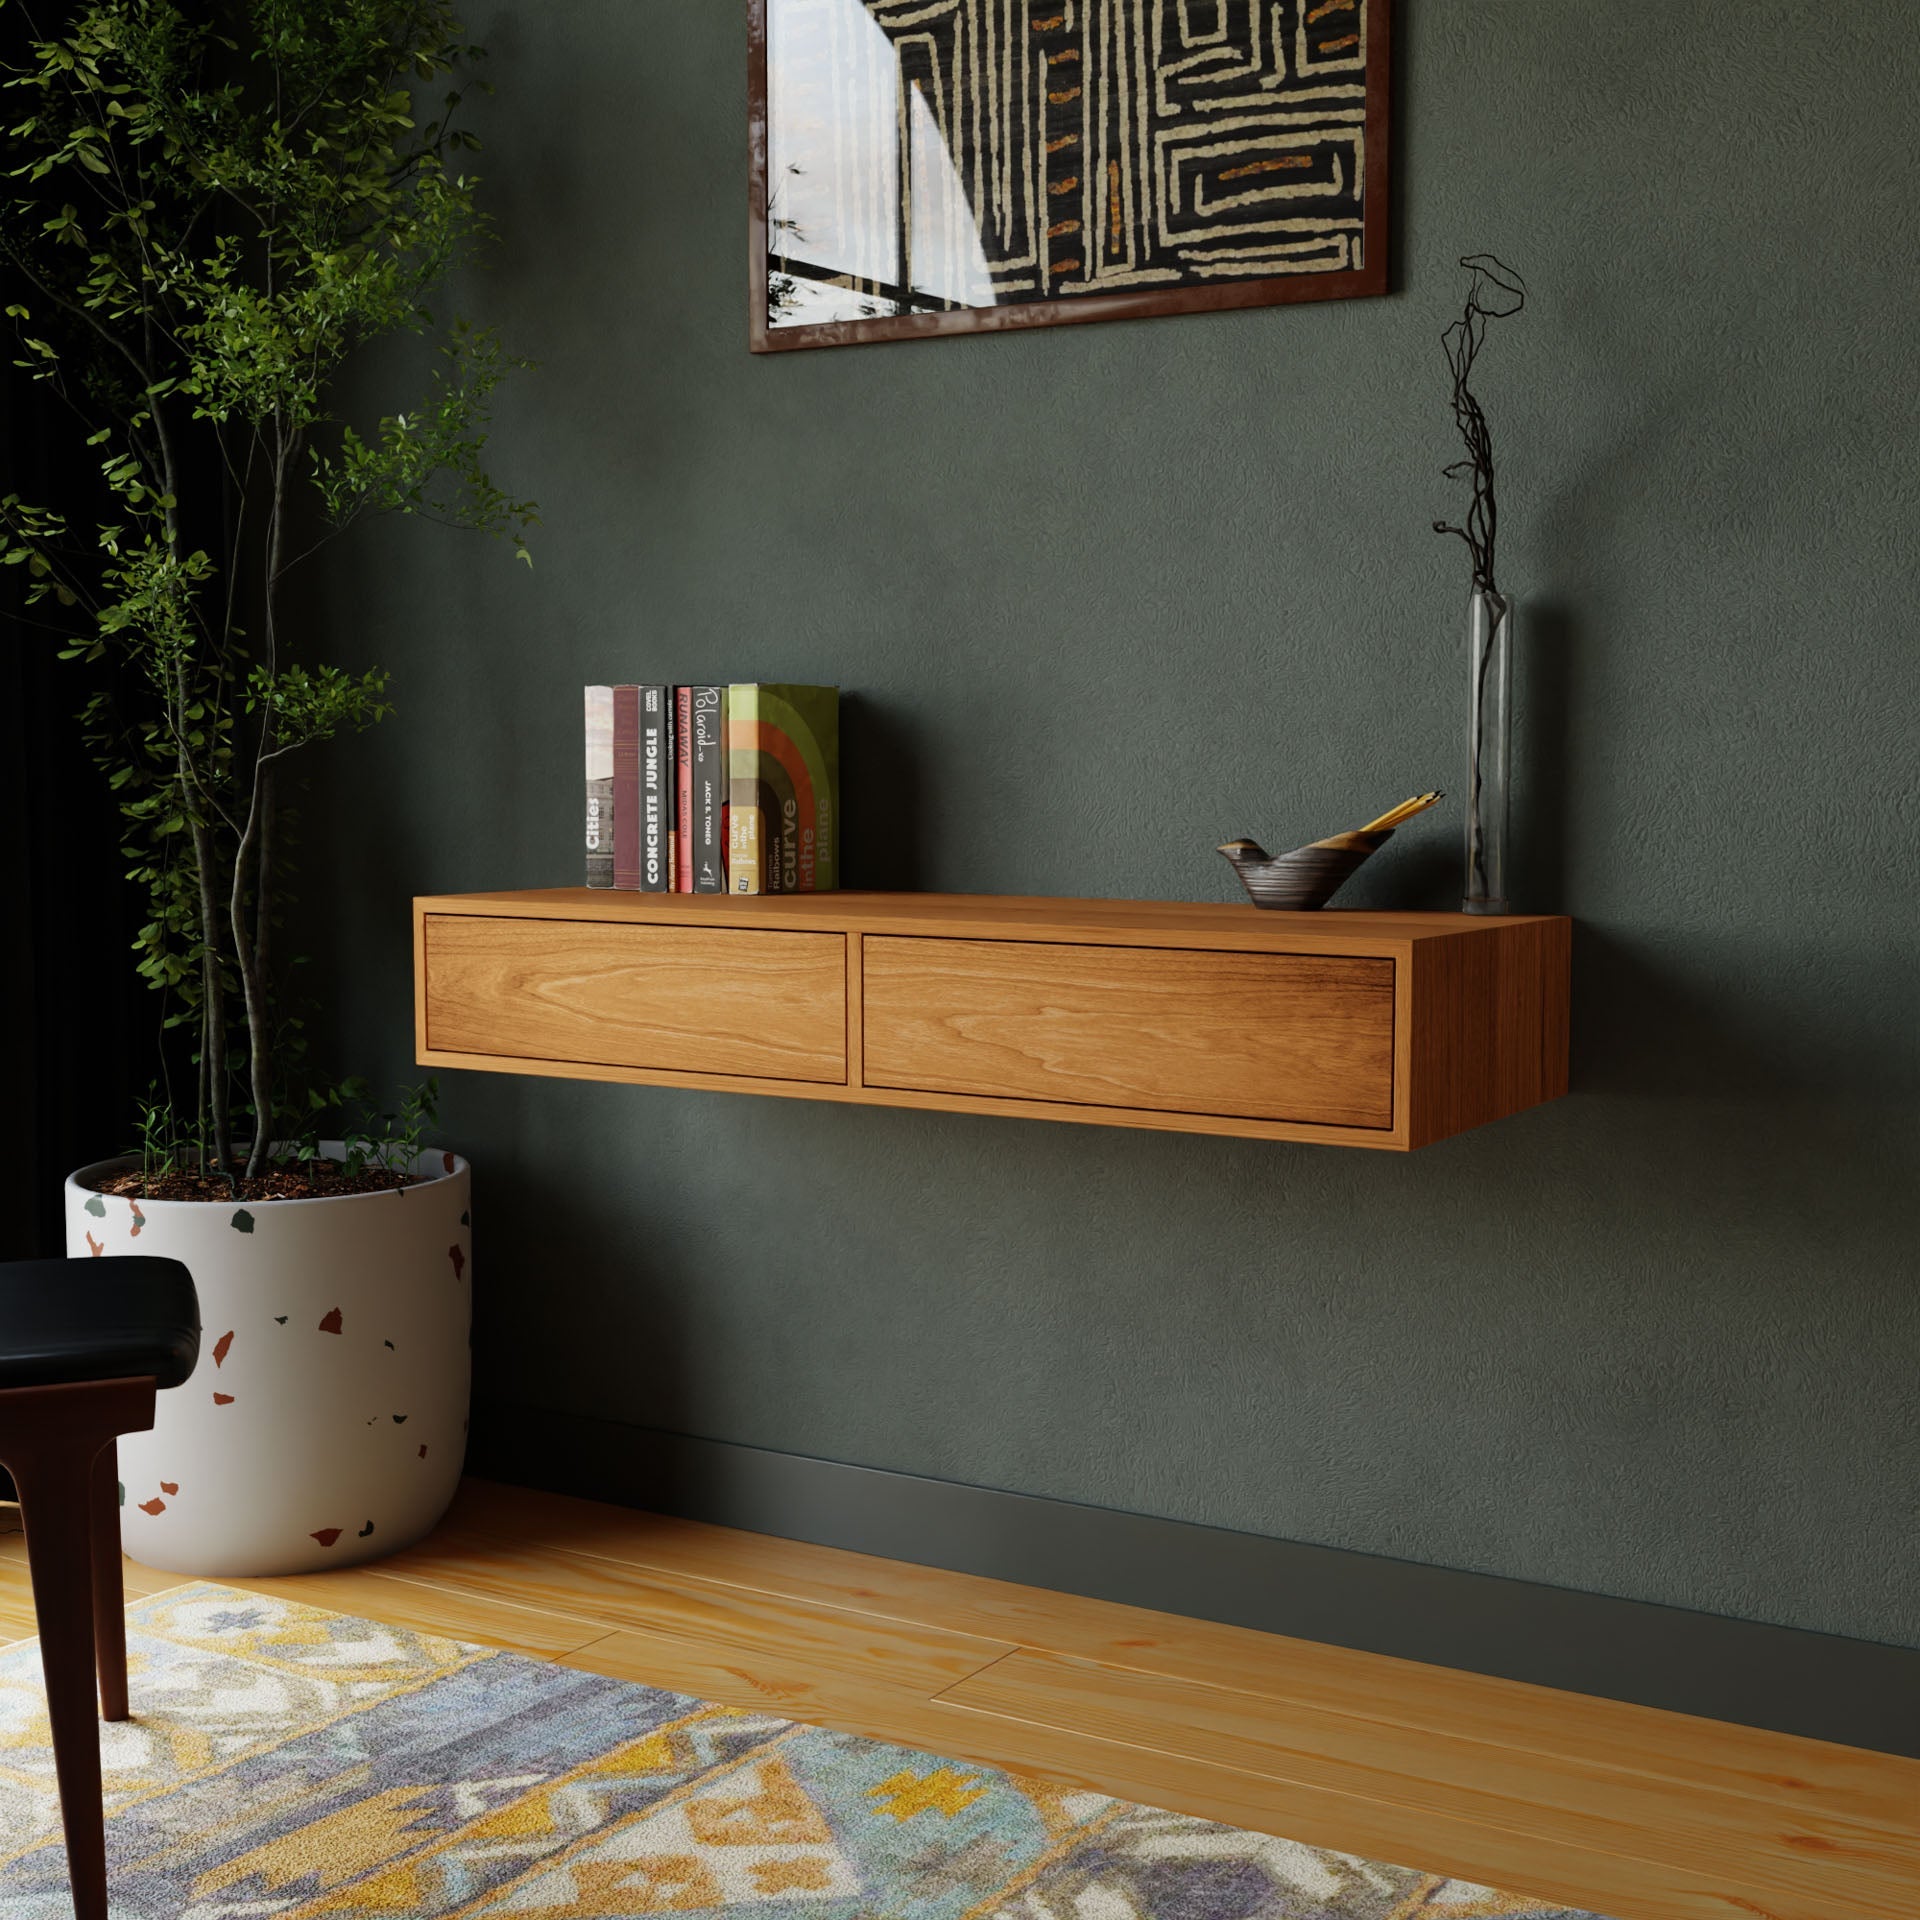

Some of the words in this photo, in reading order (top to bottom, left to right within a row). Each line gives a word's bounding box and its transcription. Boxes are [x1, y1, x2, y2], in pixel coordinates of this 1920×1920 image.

[647, 728, 658, 790] JUNGLE
[679, 693, 689, 767] RUNAWAY
[586, 798, 599, 849] Cities
[647, 796, 658, 884] CONCRETE
[784, 799, 796, 889] curve
[817, 799, 829, 862] plane
